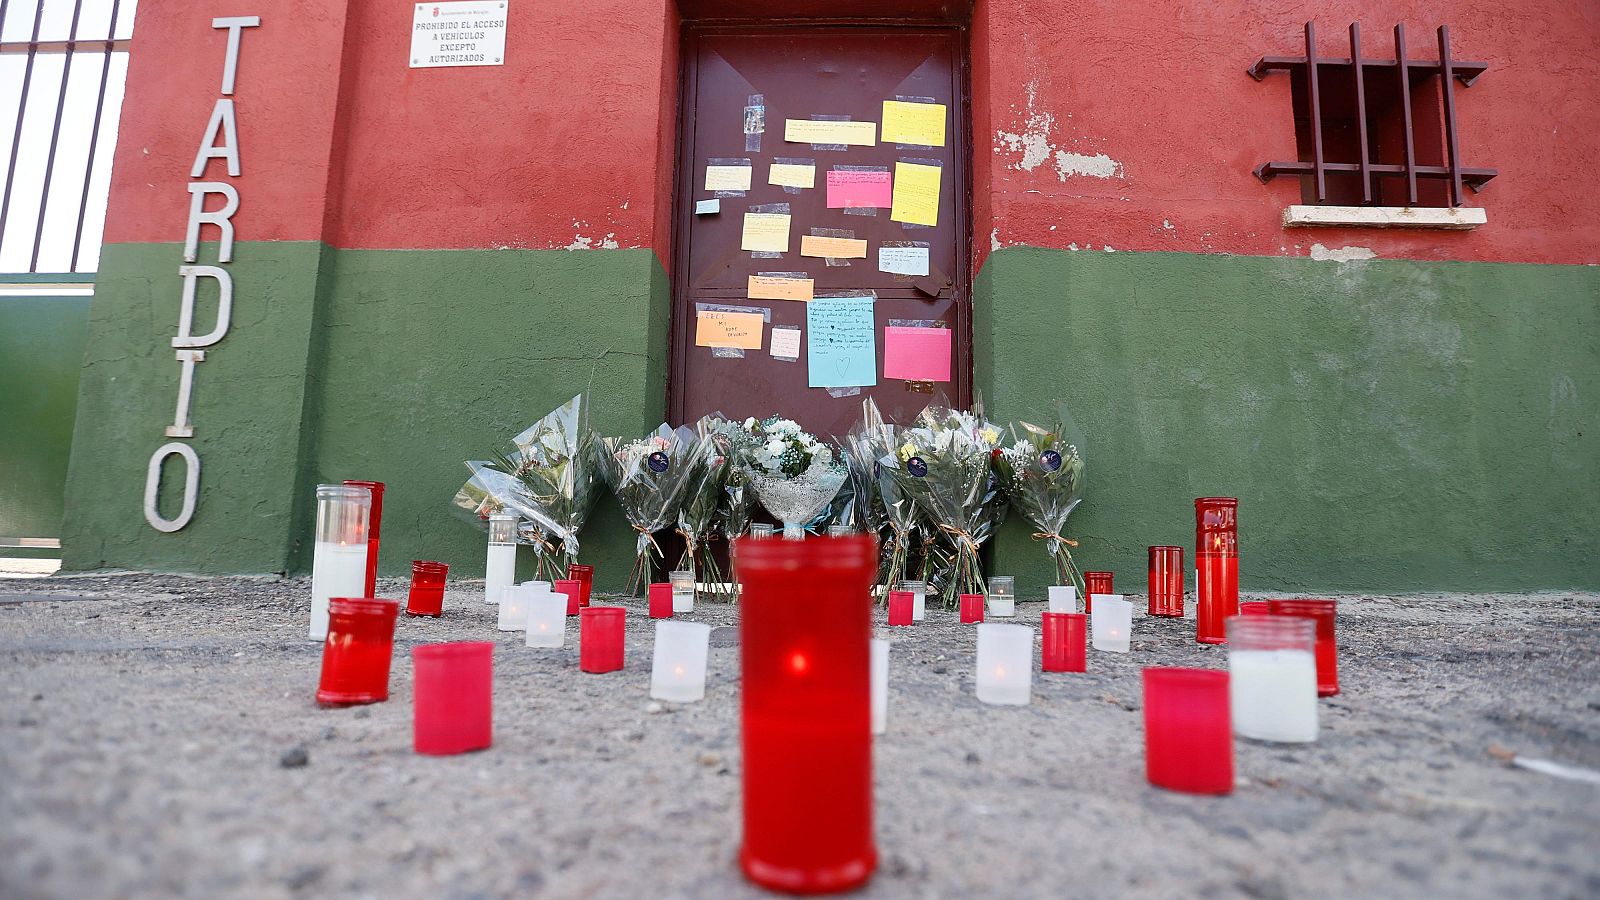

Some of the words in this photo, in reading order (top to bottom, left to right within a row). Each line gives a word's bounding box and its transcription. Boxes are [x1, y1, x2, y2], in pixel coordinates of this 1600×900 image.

[415, 22, 459, 31] PROHIBIDO
[461, 21, 471, 29] EL
[473, 20, 505, 29] ACCESO
[440, 32, 486, 40] VEHICULOS
[440, 43, 476, 51] EXCEPTO
[429, 54, 485, 63] AUTORIZADOS
[143, 15, 261, 533] TARDIO
